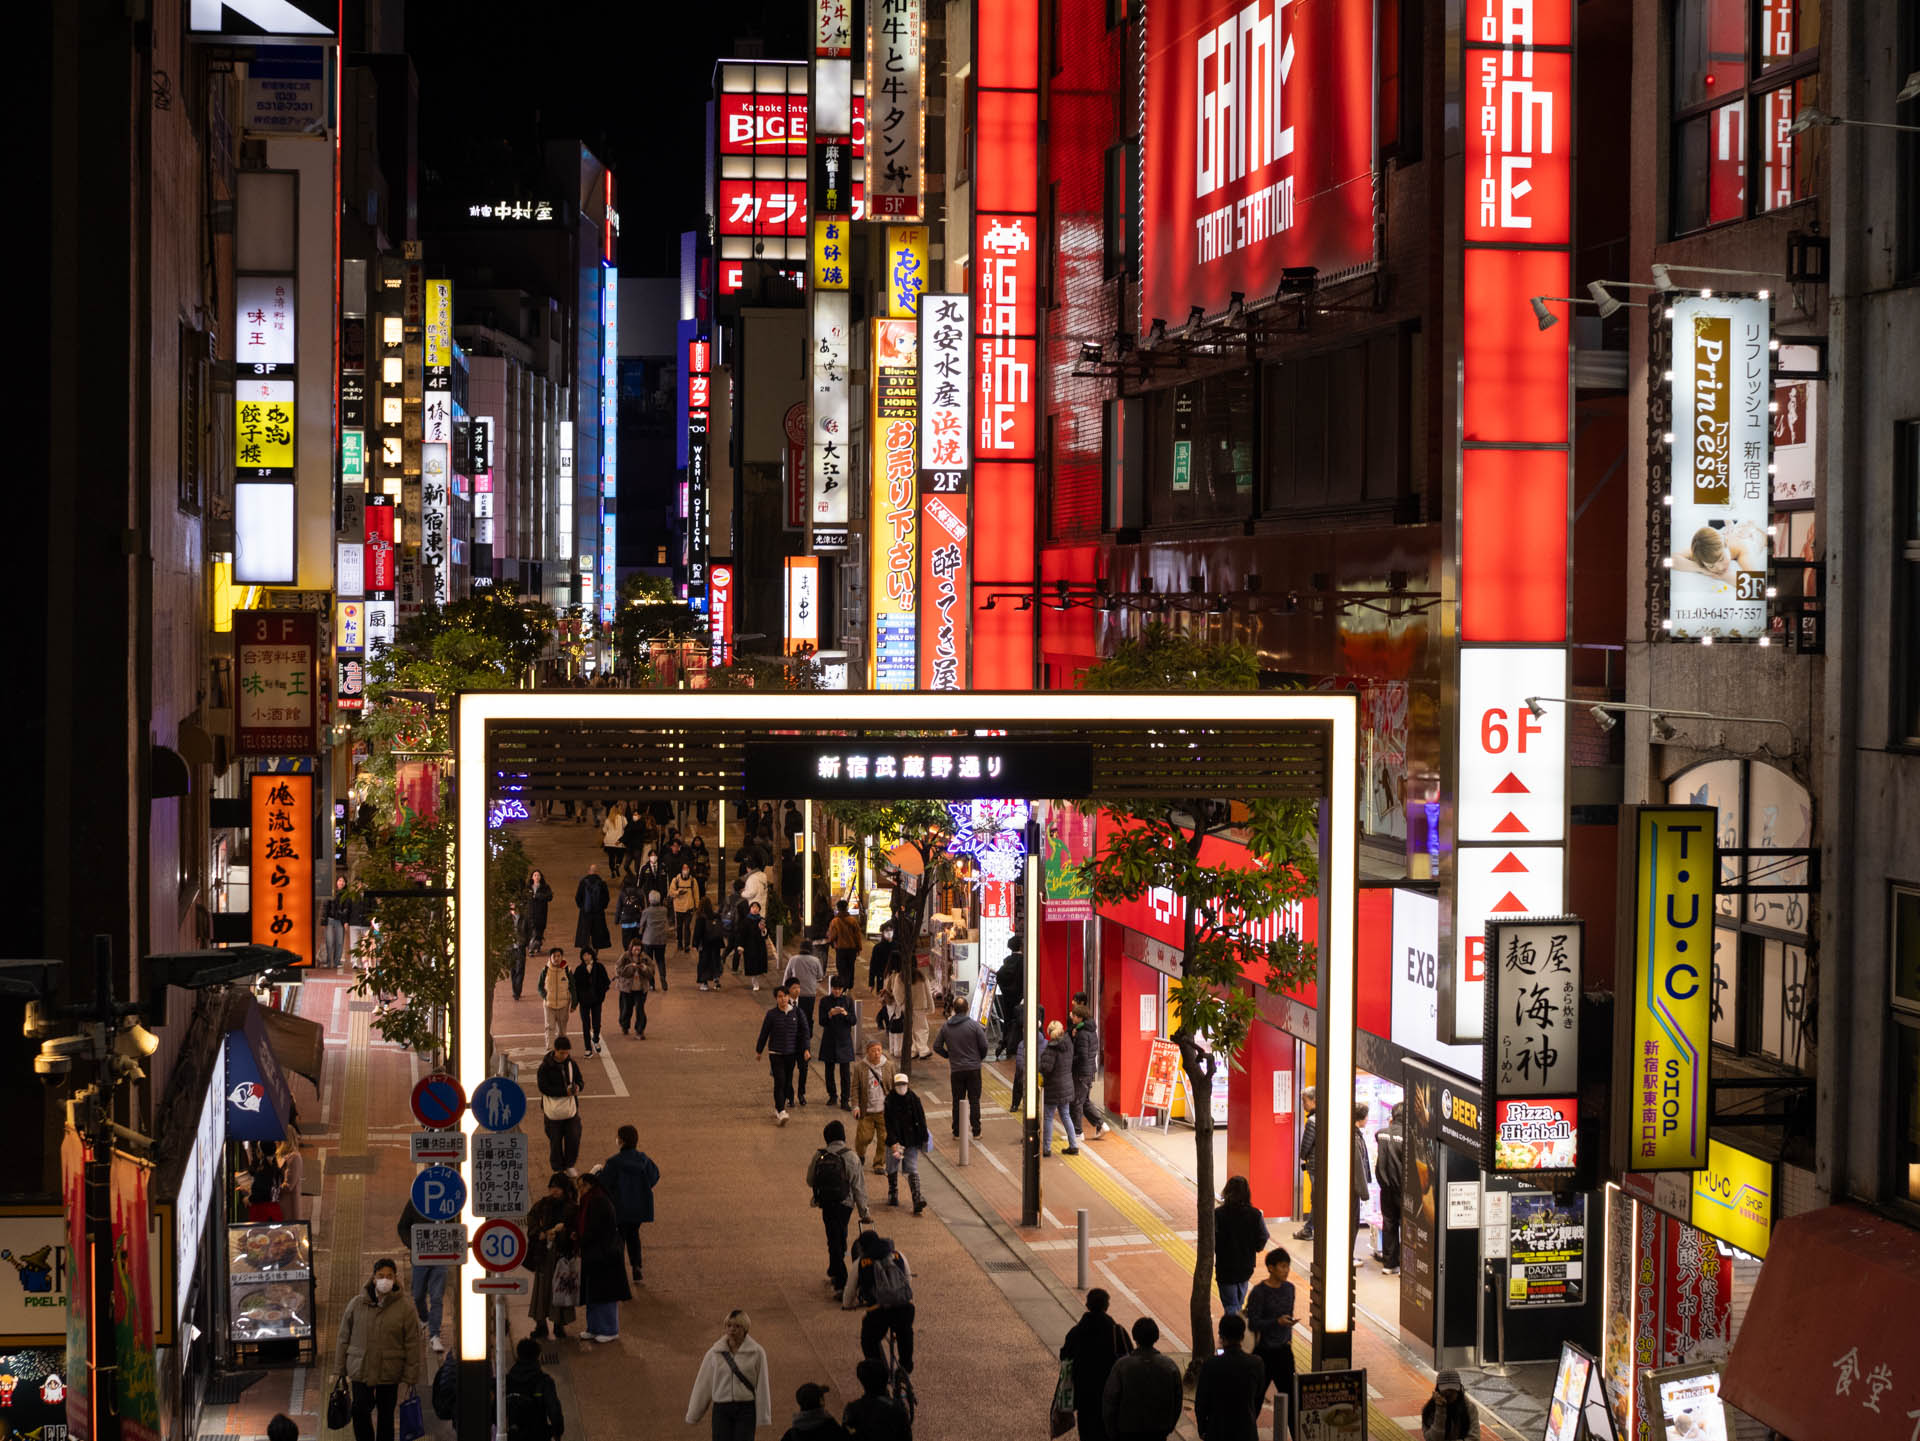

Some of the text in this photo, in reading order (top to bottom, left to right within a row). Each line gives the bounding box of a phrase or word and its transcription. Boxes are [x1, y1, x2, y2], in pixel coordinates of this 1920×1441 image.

[742, 103, 782, 113] Karaoke
[729, 114, 785, 143] BIG
[1481, 57, 1498, 227] STATION
[825, 146, 839, 172] 麻雀
[885, 197, 904, 213] 5F
[1197, 175, 1294, 264] TAITO STATION
[900, 231, 918, 244] 4F
[822, 224, 843, 285] お好焼
[247, 309, 267, 345] 味王
[982, 259, 993, 449] TAITO STATION
[995, 259, 1028, 449] GAME
[252, 363, 277, 375] 3F
[431, 366, 445, 375] 4F
[885, 368, 916, 376] Blu-ra
[889, 377, 914, 386] DVD
[931, 300, 963, 464] 丸安水産浜焼
[1744, 323, 1762, 428] リフレッシュ
[428, 378, 447, 389] 4F
[1696, 335, 1723, 490] Princess
[258, 469, 272, 477] 2F
[822, 441, 840, 494] 大江戸
[933, 472, 962, 491] 2F
[373, 496, 385, 505] 2F
[693, 446, 702, 551] WASHIN OPTICAL
[374, 591, 385, 600] 1F
[1737, 572, 1765, 599] 3F
[344, 619, 357, 644] 松屋
[243, 650, 308, 665] 台湾料理
[1481, 707, 1542, 753] 6F
[818, 756, 1003, 778] 新宿武蔵野通り
[1408, 946, 1438, 991] EXB
[1562, 981, 1574, 1030] あら炊き
[1516, 982, 1559, 1087] 海神
[1501, 1035, 1513, 1084] らーめん
[1641, 1039, 1660, 1158] 新宿駅東南口店
[1663, 1059, 1680, 1137] SHOP
[1452, 1095, 1478, 1131] BEER
[1508, 1103, 1553, 1122] Pizza
[1502, 1120, 1570, 1143] Highball
[439, 1198, 455, 1214] 40
[485, 1234, 515, 1258] 30
[1528, 1265, 1554, 1275] DAZN
[24, 1296, 58, 1308] PIXEL
[1832, 1345, 1893, 1413] 食堂
